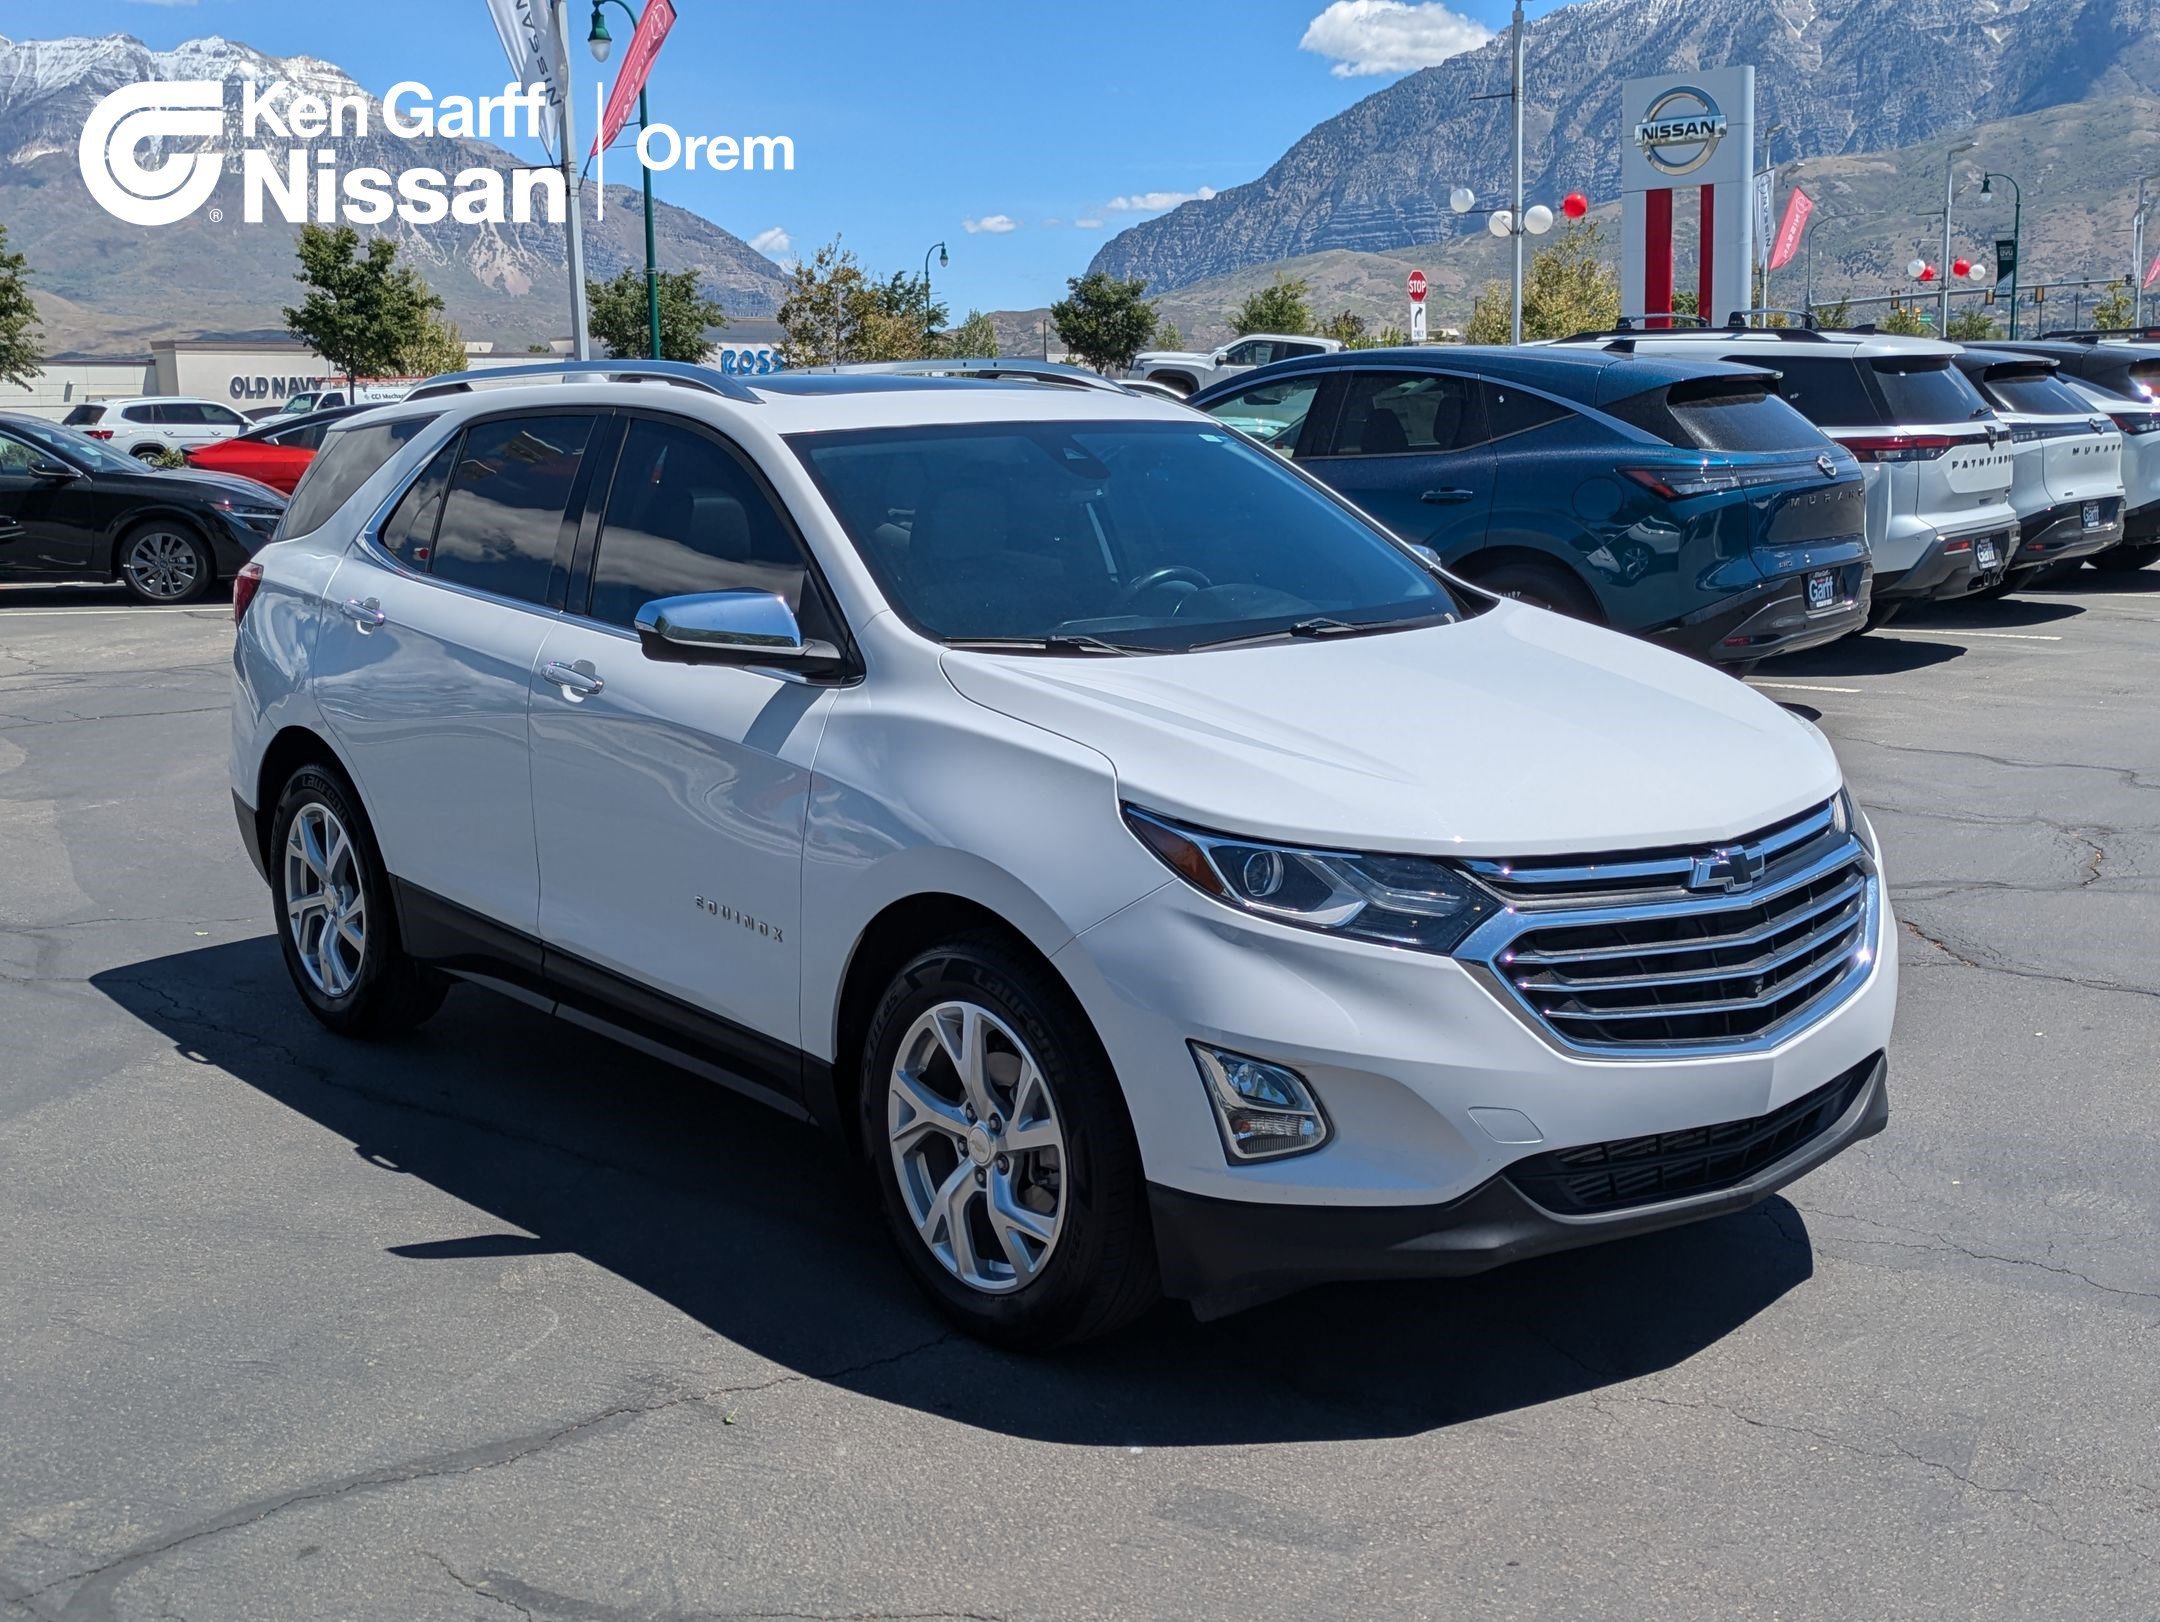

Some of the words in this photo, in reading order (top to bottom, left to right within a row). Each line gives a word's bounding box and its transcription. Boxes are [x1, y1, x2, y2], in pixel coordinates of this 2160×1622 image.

[1641, 119, 1716, 140] NISSAN
[1408, 280, 1427, 293] STOP
[230, 376, 269, 399] OLD
[1790, 487, 1865, 509] MURANO
[1977, 542, 1995, 562] Garff
[1809, 575, 1834, 602] Garff
[695, 895, 784, 942] EQUINOX
